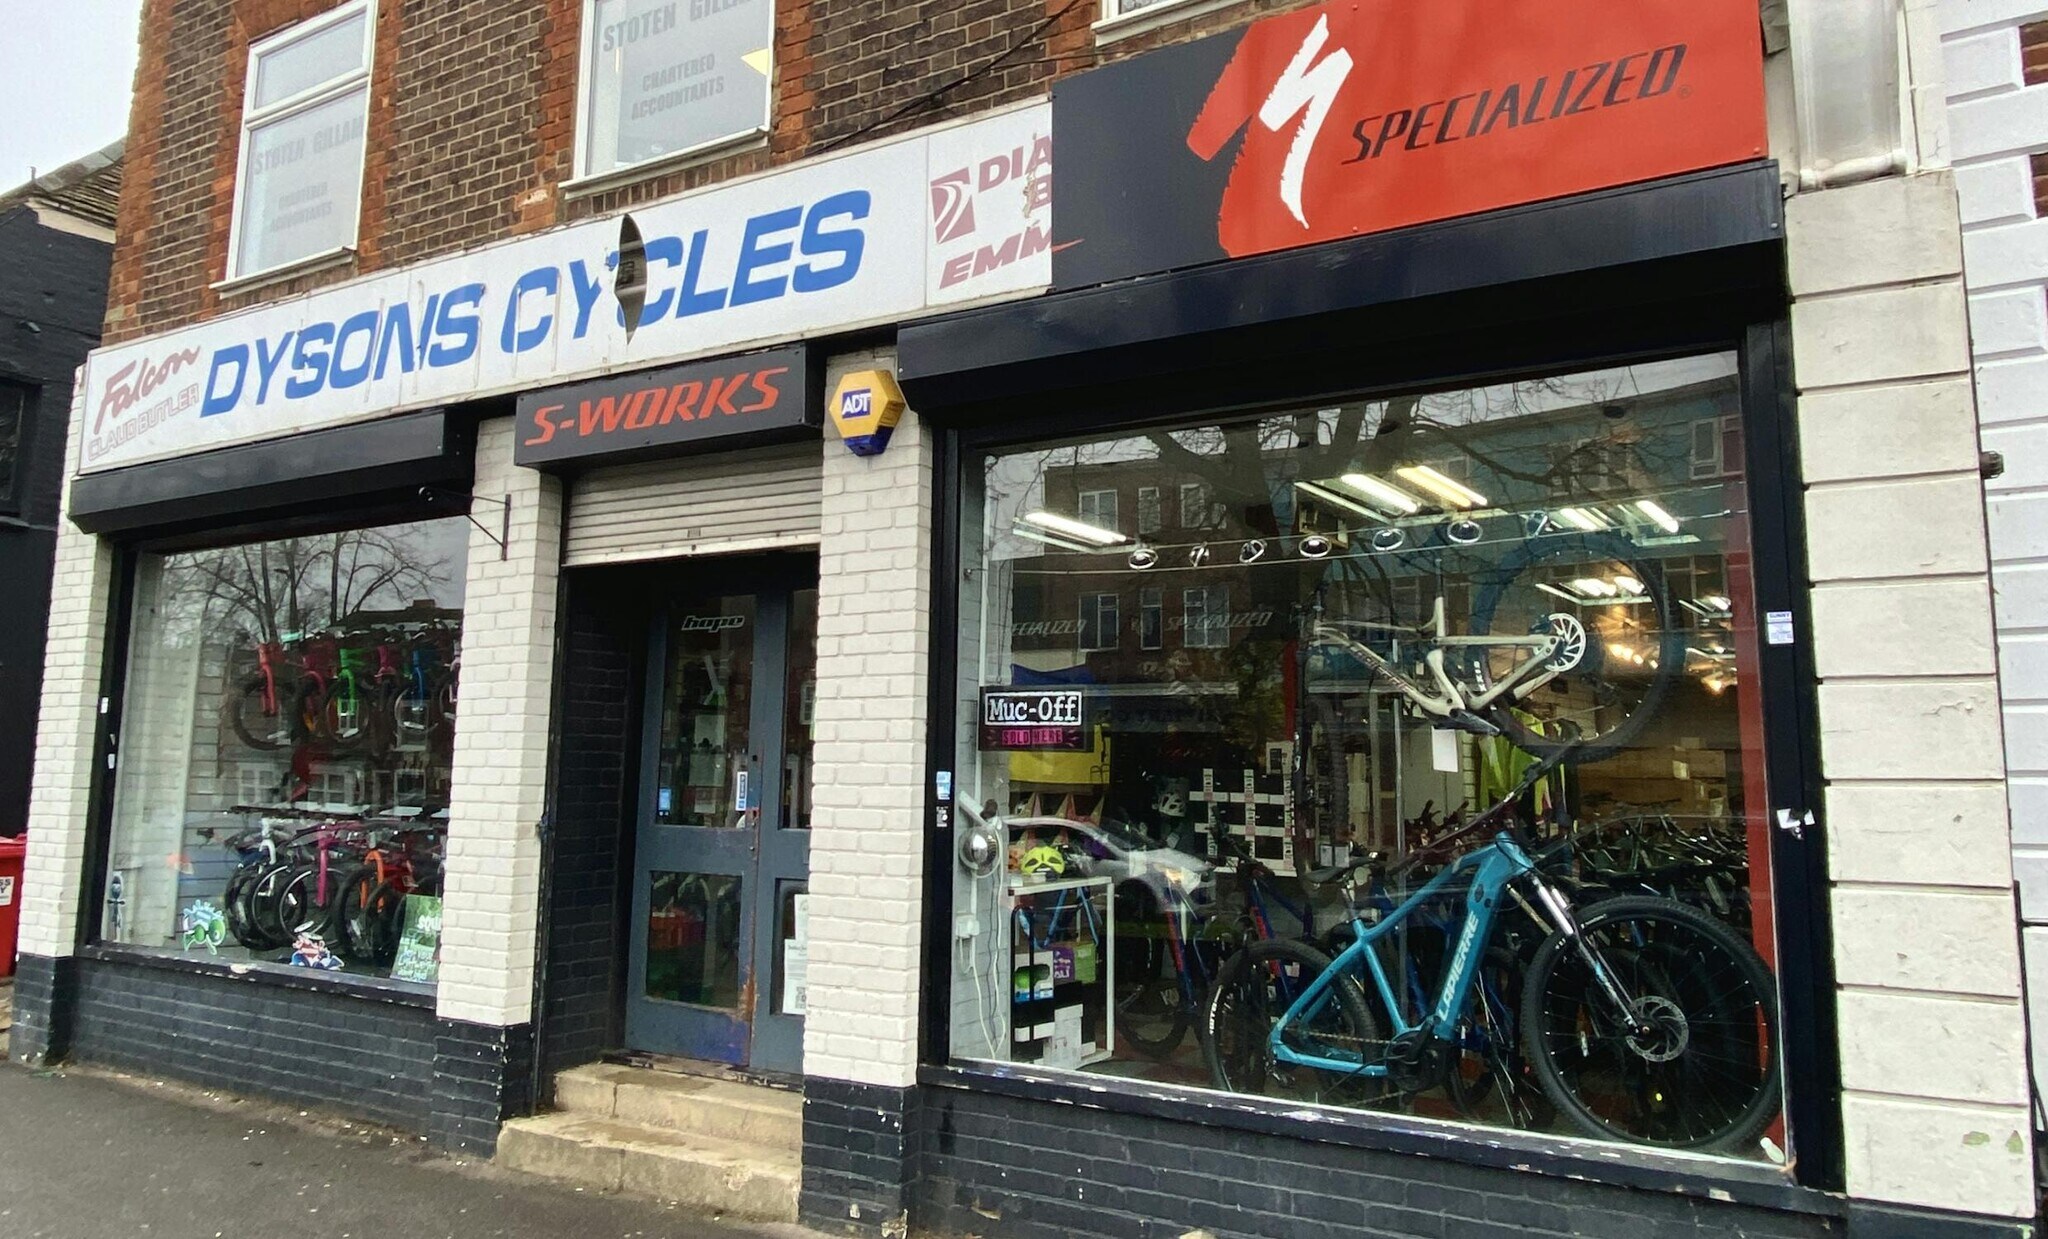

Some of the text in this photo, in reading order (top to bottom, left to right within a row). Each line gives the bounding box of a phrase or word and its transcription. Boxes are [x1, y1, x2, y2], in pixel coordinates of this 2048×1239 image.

[602, 2, 677, 51] STOTEN
[642, 53, 715, 92] CHARTERED
[631, 76, 724, 120] ACCOUNTANTS
[1341, 43, 1688, 165] SPECIALIZED
[200, 190, 871, 418] DYSONS CYCLES
[94, 345, 200, 435] Falcon
[525, 366, 790, 447] S-WORKS
[842, 391, 871, 414] ADT
[88, 383, 199, 461] CLAUD BUTLER
[681, 615, 745, 632] hope
[1165, 611, 1273, 631] SPECIALIZED
[988, 696, 1078, 721] Muc-Off
[1003, 730, 1030, 745] SOLD
[1439, 910, 1479, 1022] LAPIERRE
